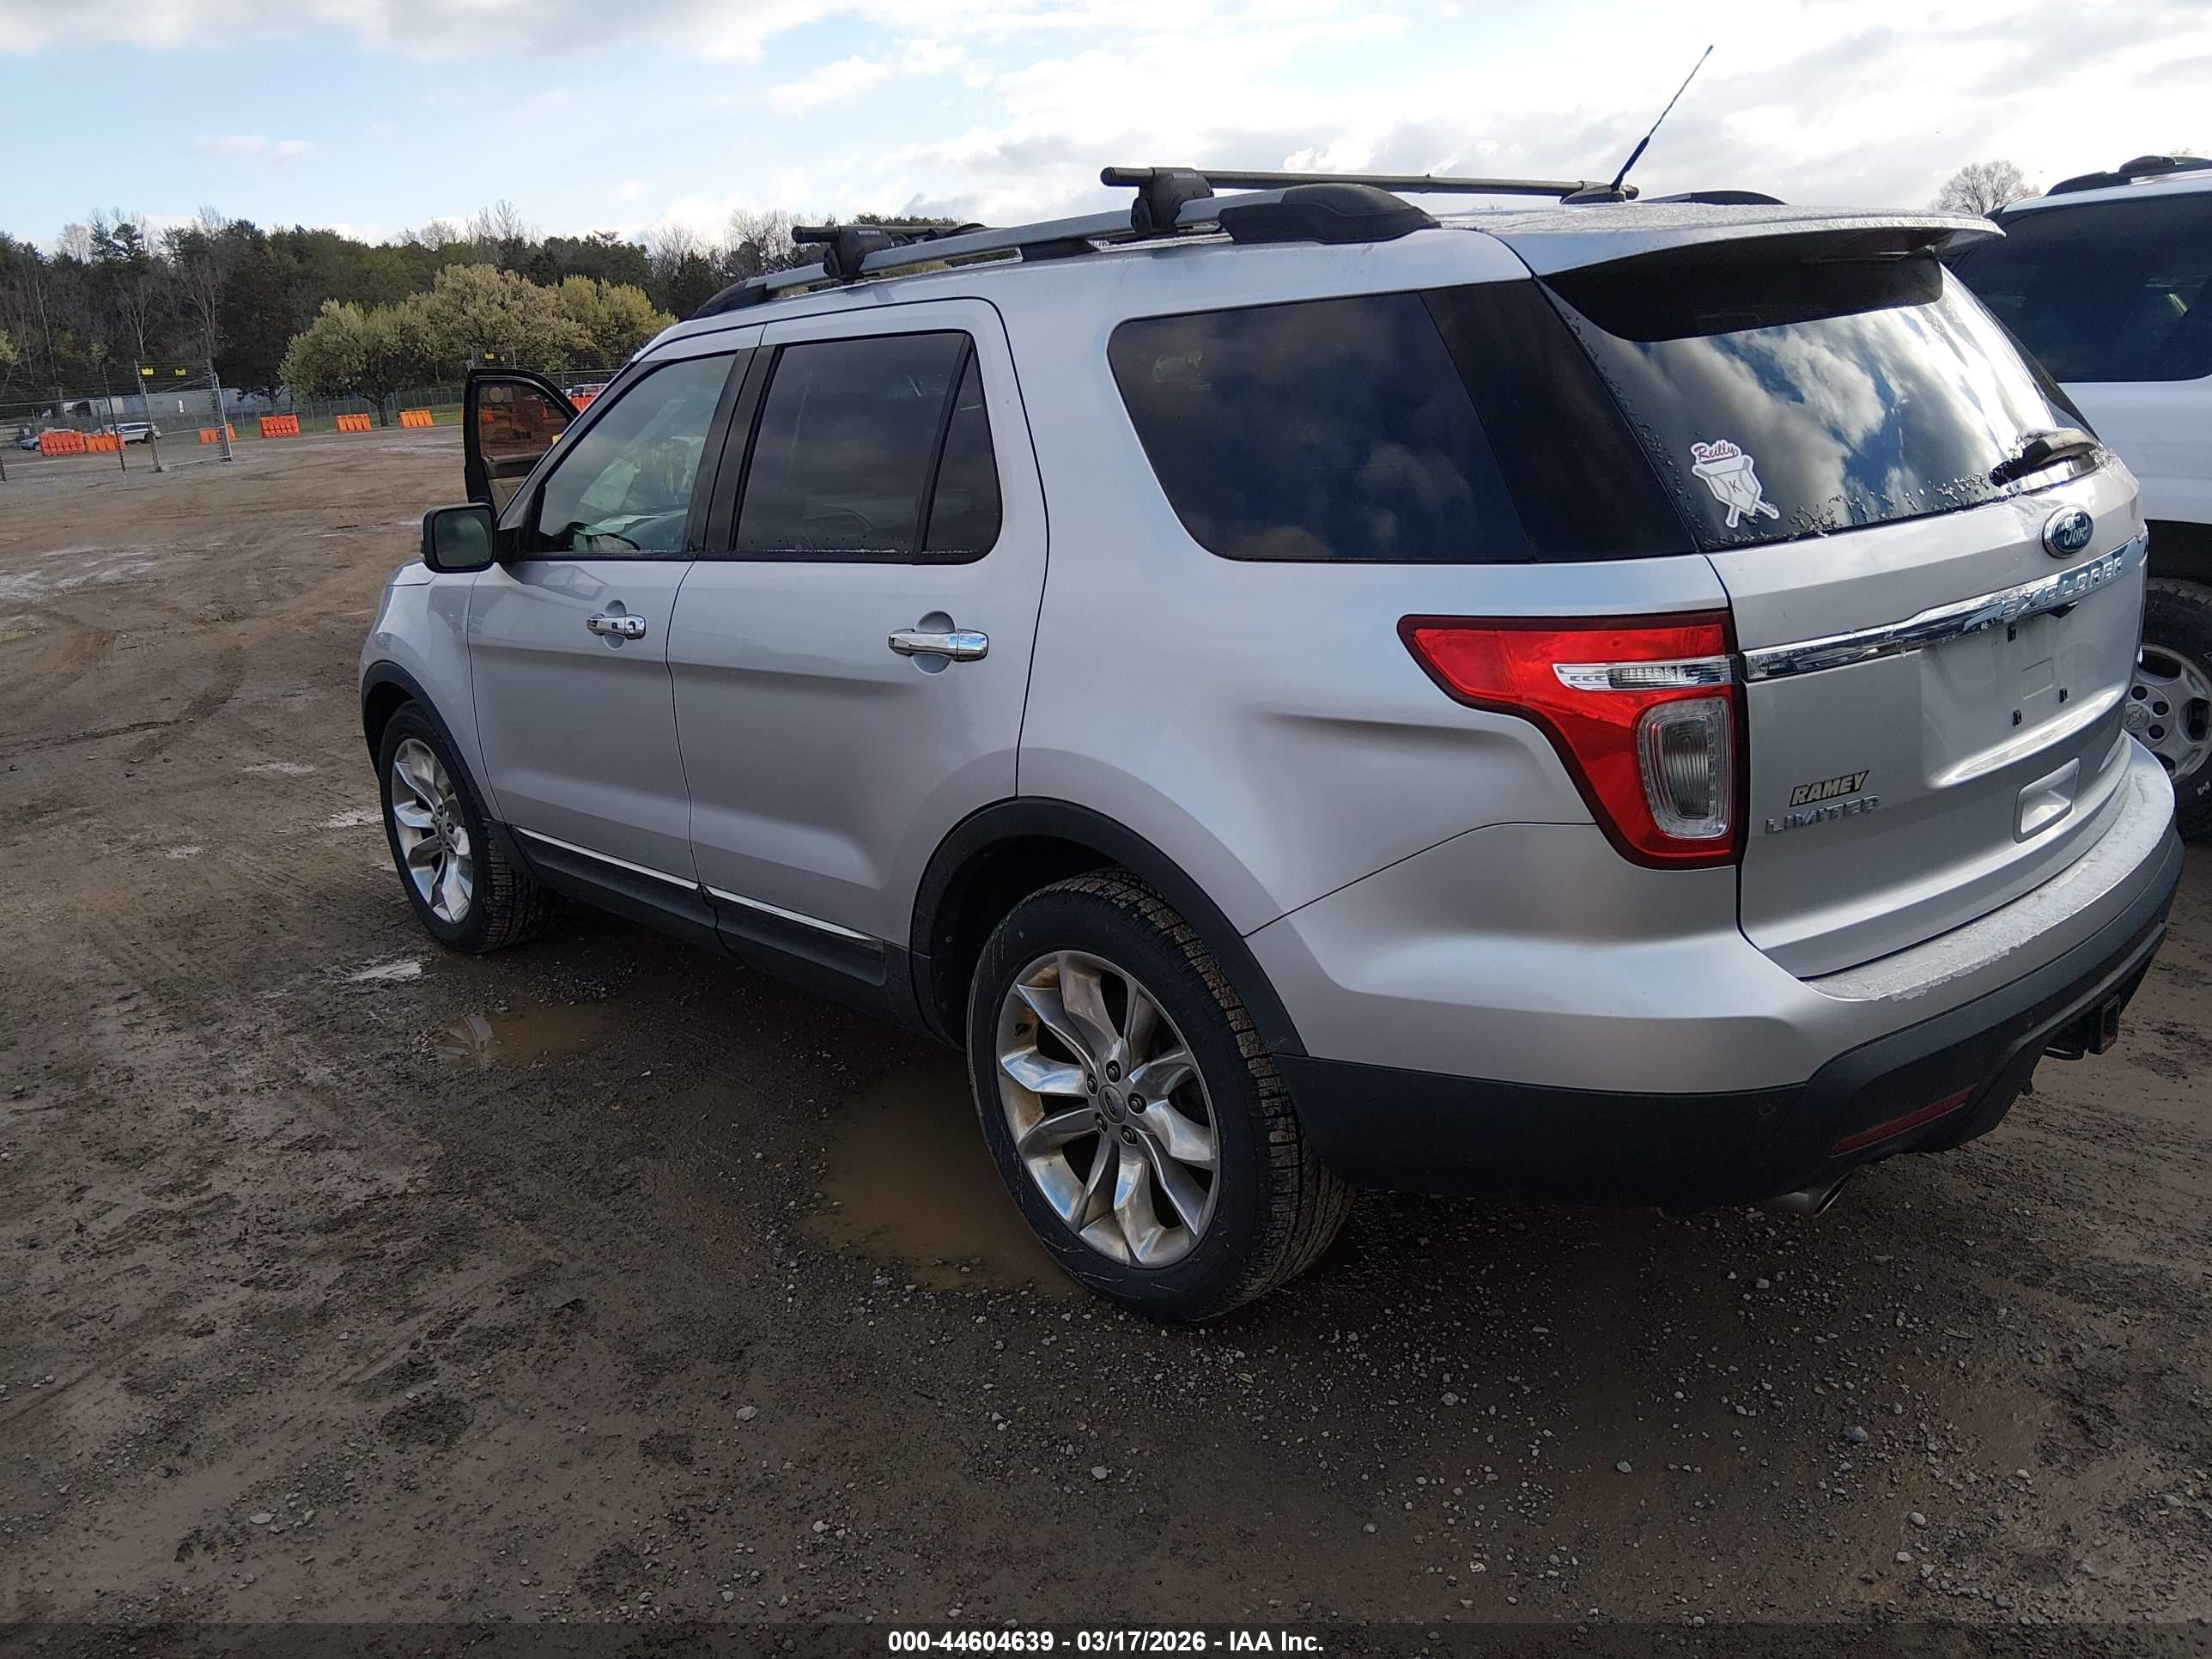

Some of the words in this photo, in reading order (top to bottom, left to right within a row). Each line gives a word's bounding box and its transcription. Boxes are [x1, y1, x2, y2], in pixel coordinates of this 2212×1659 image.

[1694, 443, 1739, 463] Reilly
[1729, 479, 1742, 493] K
[2063, 514, 2089, 545] Ford
[2002, 556, 2124, 615] EXPLORER
[1791, 771, 1868, 806] RAMEY
[1765, 795, 1881, 833] LIMITED
